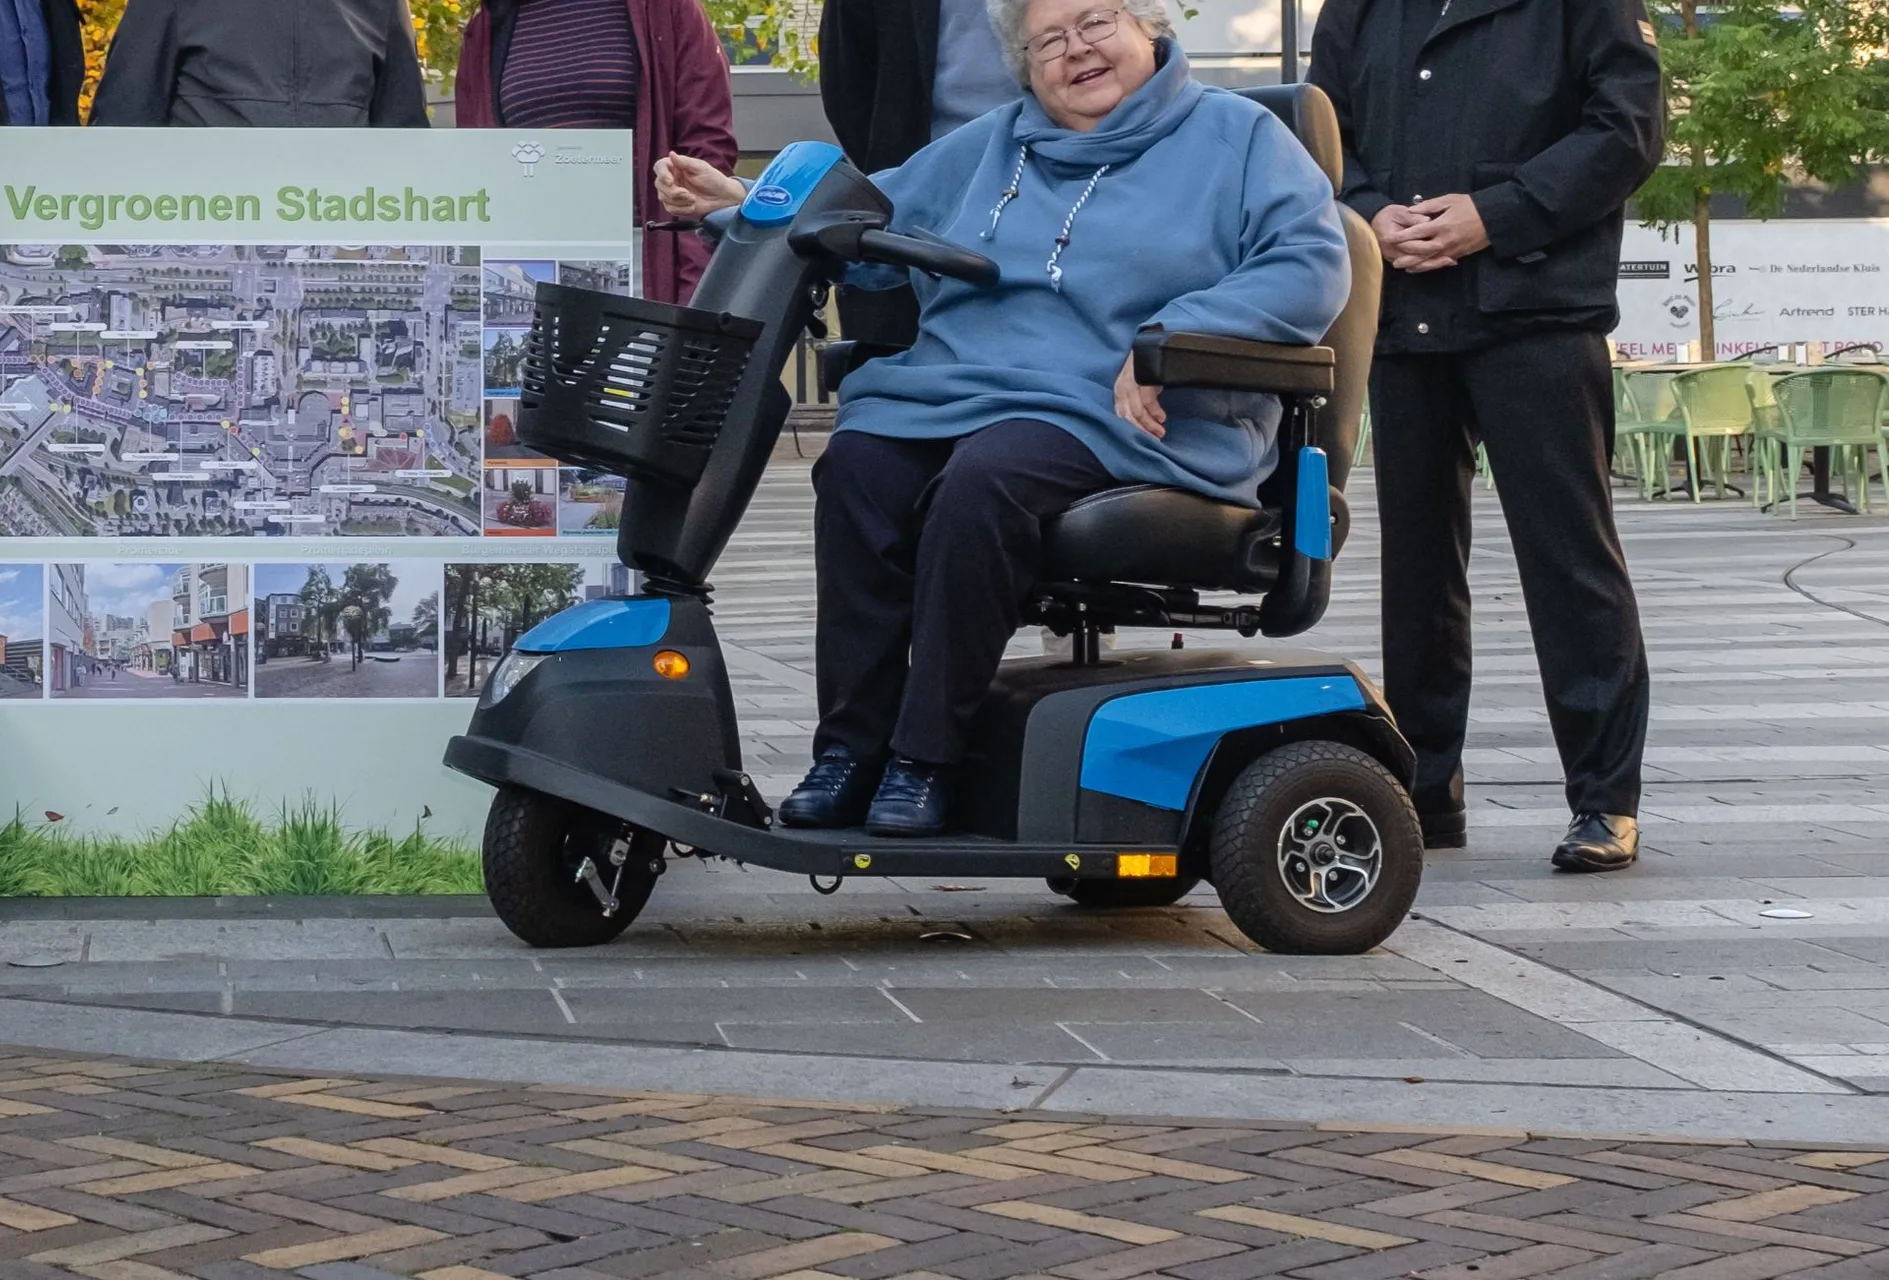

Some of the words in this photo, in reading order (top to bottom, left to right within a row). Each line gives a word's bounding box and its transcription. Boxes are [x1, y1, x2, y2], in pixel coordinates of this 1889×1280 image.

[4, 184, 260, 230] Vergroenen
[275, 185, 490, 223] Stadshart
[1619, 263, 1667, 271] ATERTUIN
[1786, 264, 1850, 273] Nederlandse
[1848, 306, 1875, 317] STER
[1716, 341, 1772, 355] INKELS
